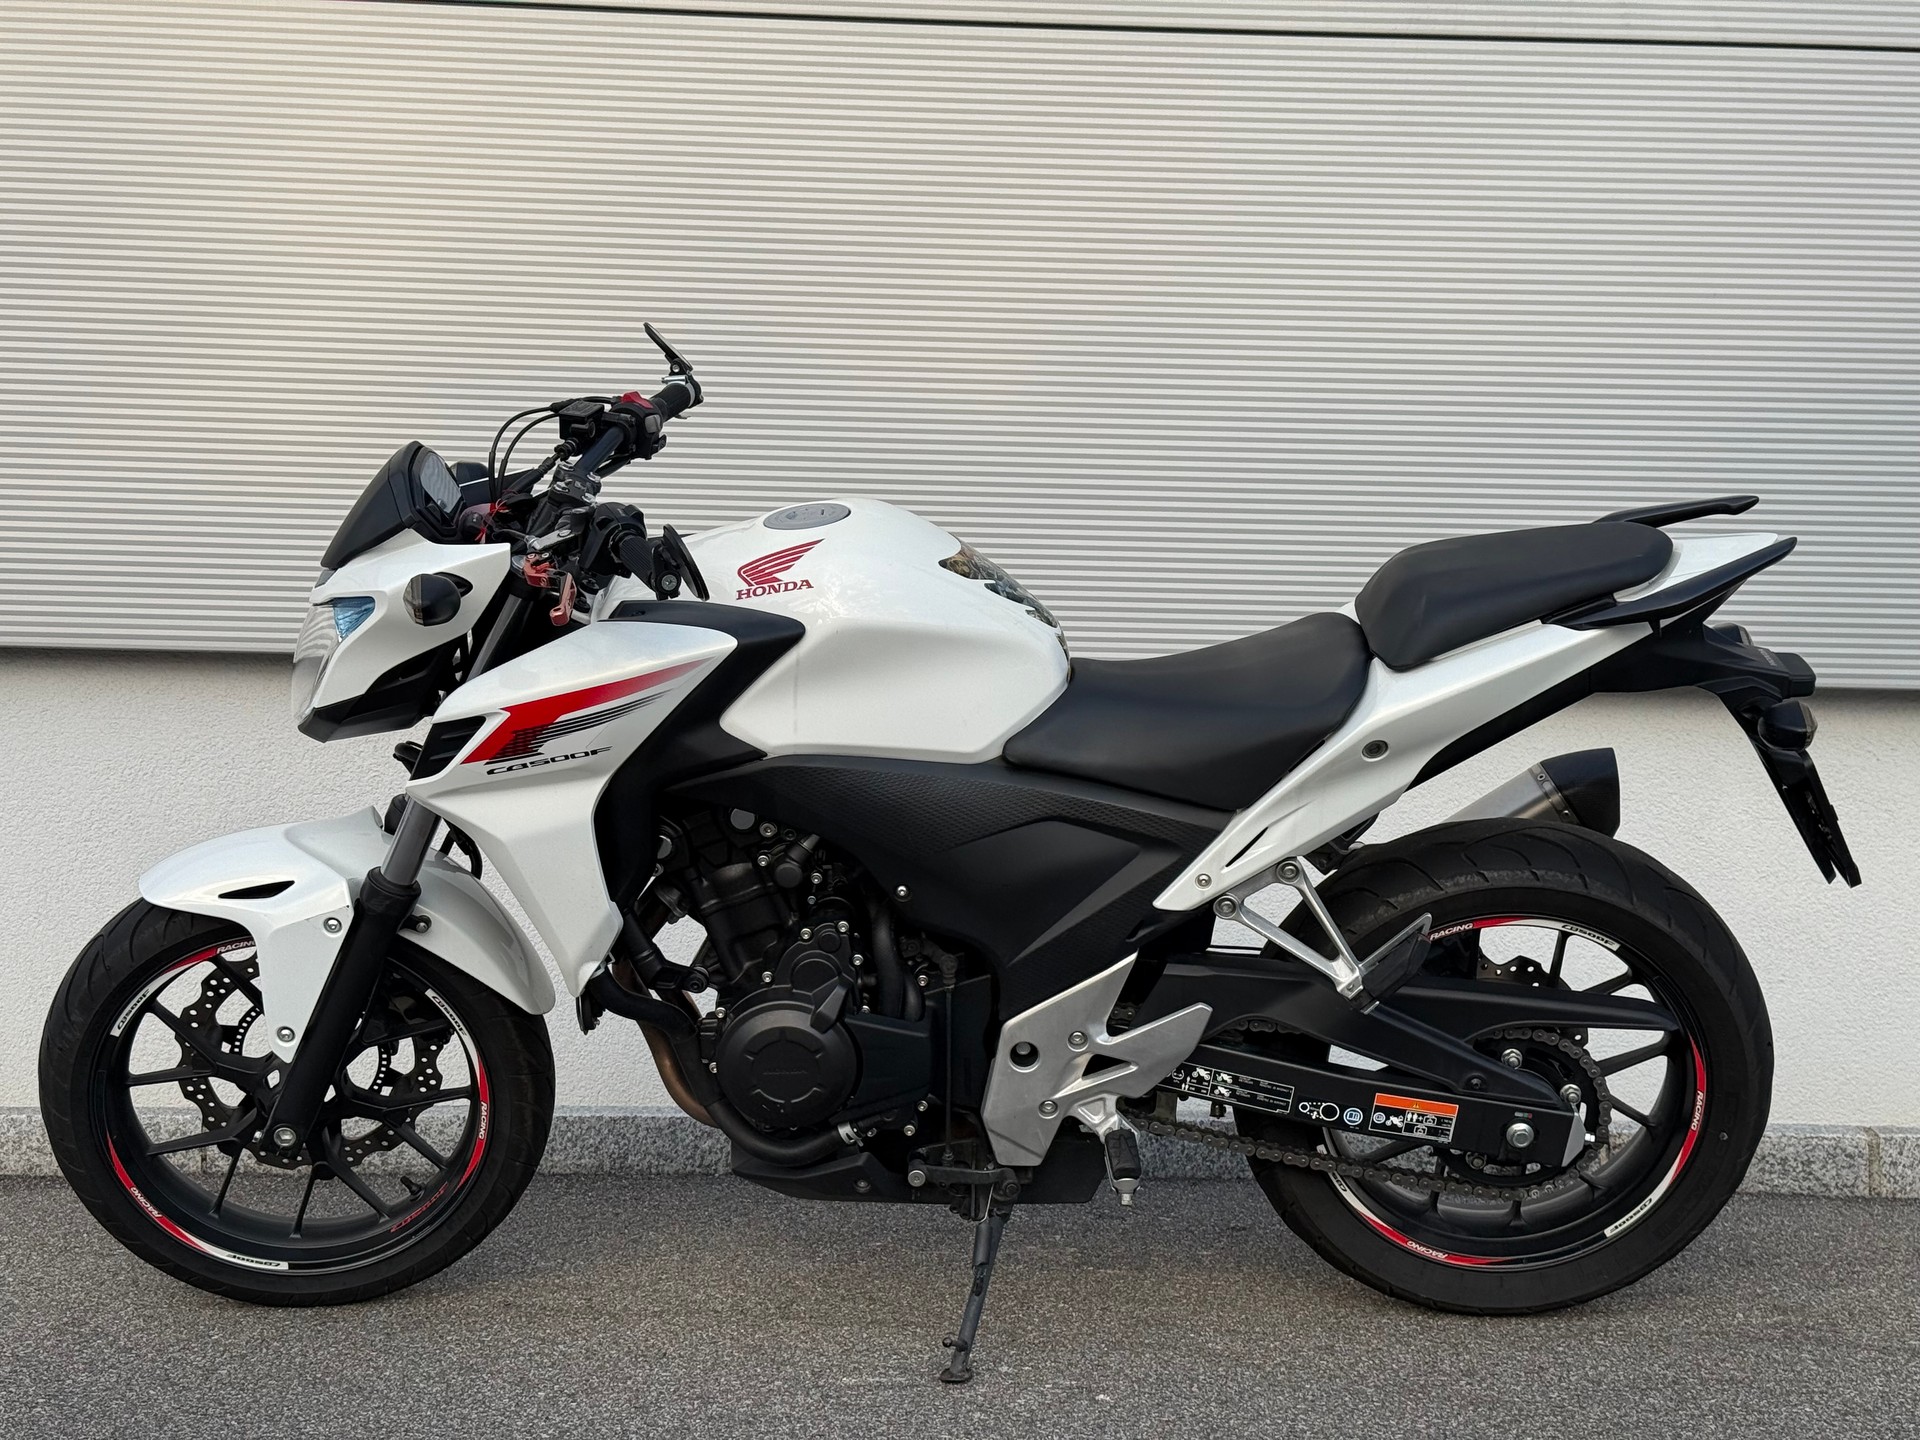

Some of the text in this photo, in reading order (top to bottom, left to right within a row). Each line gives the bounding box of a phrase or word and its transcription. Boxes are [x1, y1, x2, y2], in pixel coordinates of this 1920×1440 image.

[736, 579, 814, 600] HONDA
[486, 746, 613, 775] CB500F
[1429, 922, 1615, 947] RACING CB500F
[117, 988, 149, 1030] CB500F
[431, 995, 488, 1140] CB500F RACING
[1691, 1090, 1704, 1131] RACING
[130, 1186, 162, 1218] RACING
[1407, 1240, 1448, 1259] RACING
